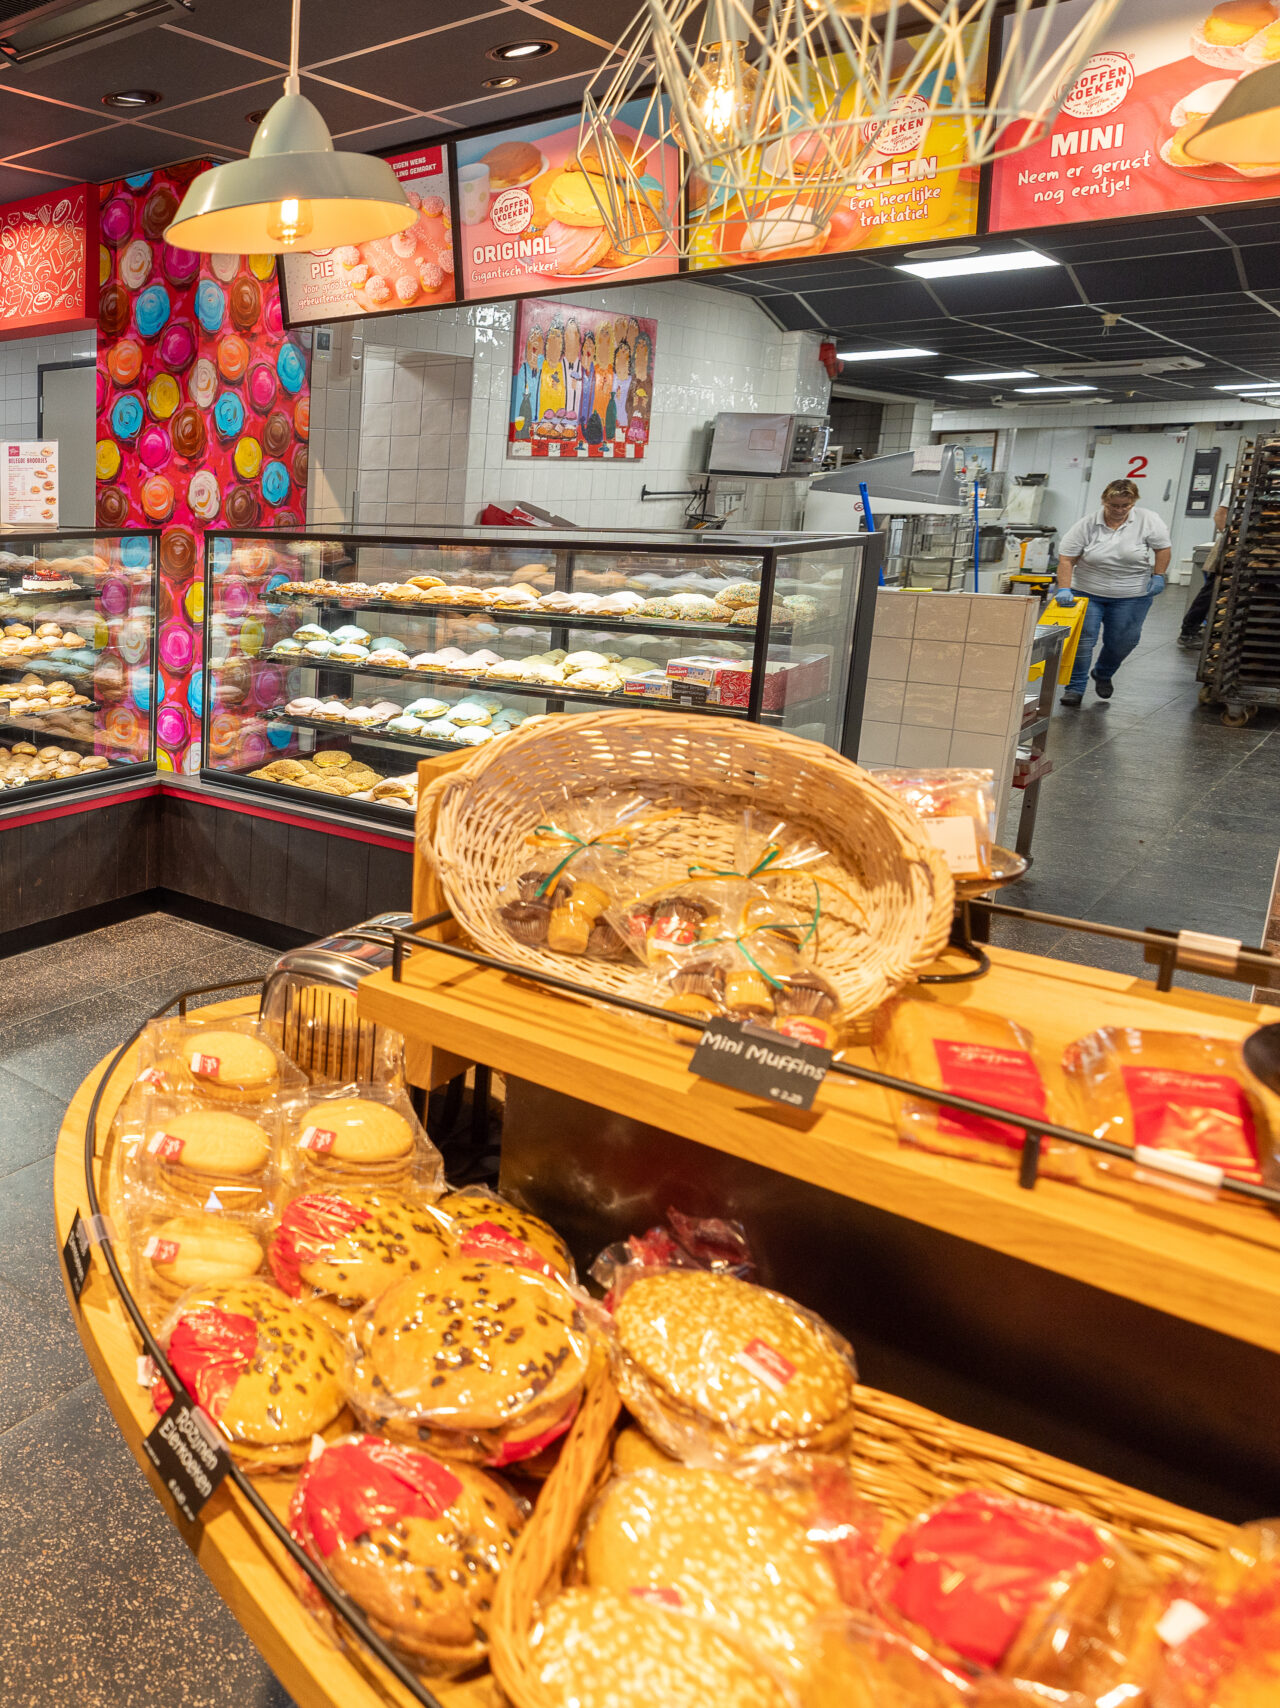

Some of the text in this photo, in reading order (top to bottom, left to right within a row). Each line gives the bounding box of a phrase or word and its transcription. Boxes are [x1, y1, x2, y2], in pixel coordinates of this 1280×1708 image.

[1066, 77, 1126, 102] KOEKEN
[1069, 66, 1127, 91] ROFFEN
[1050, 123, 1124, 158] MINI
[392, 156, 426, 170] EIGEN WENS
[409, 163, 437, 175] GEMAAKT
[856, 156, 938, 191] KLEIN
[1018, 149, 1152, 187] Neem er gerust
[850, 185, 941, 211] Een heerlijke
[1034, 174, 1131, 205] nog eentje!
[493, 198, 530, 216] GROFFEN
[497, 207, 529, 222] KOEKEN
[860, 204, 929, 227] traktatie!
[473, 236, 556, 265] ORIGINAL
[311, 260, 335, 279] PIE
[471, 259, 559, 284] Gigantisch lekker!
[302, 283, 320, 294] Voor
[1126, 455, 1149, 478] 2
[700, 1030, 827, 1081] Mini Muffins
